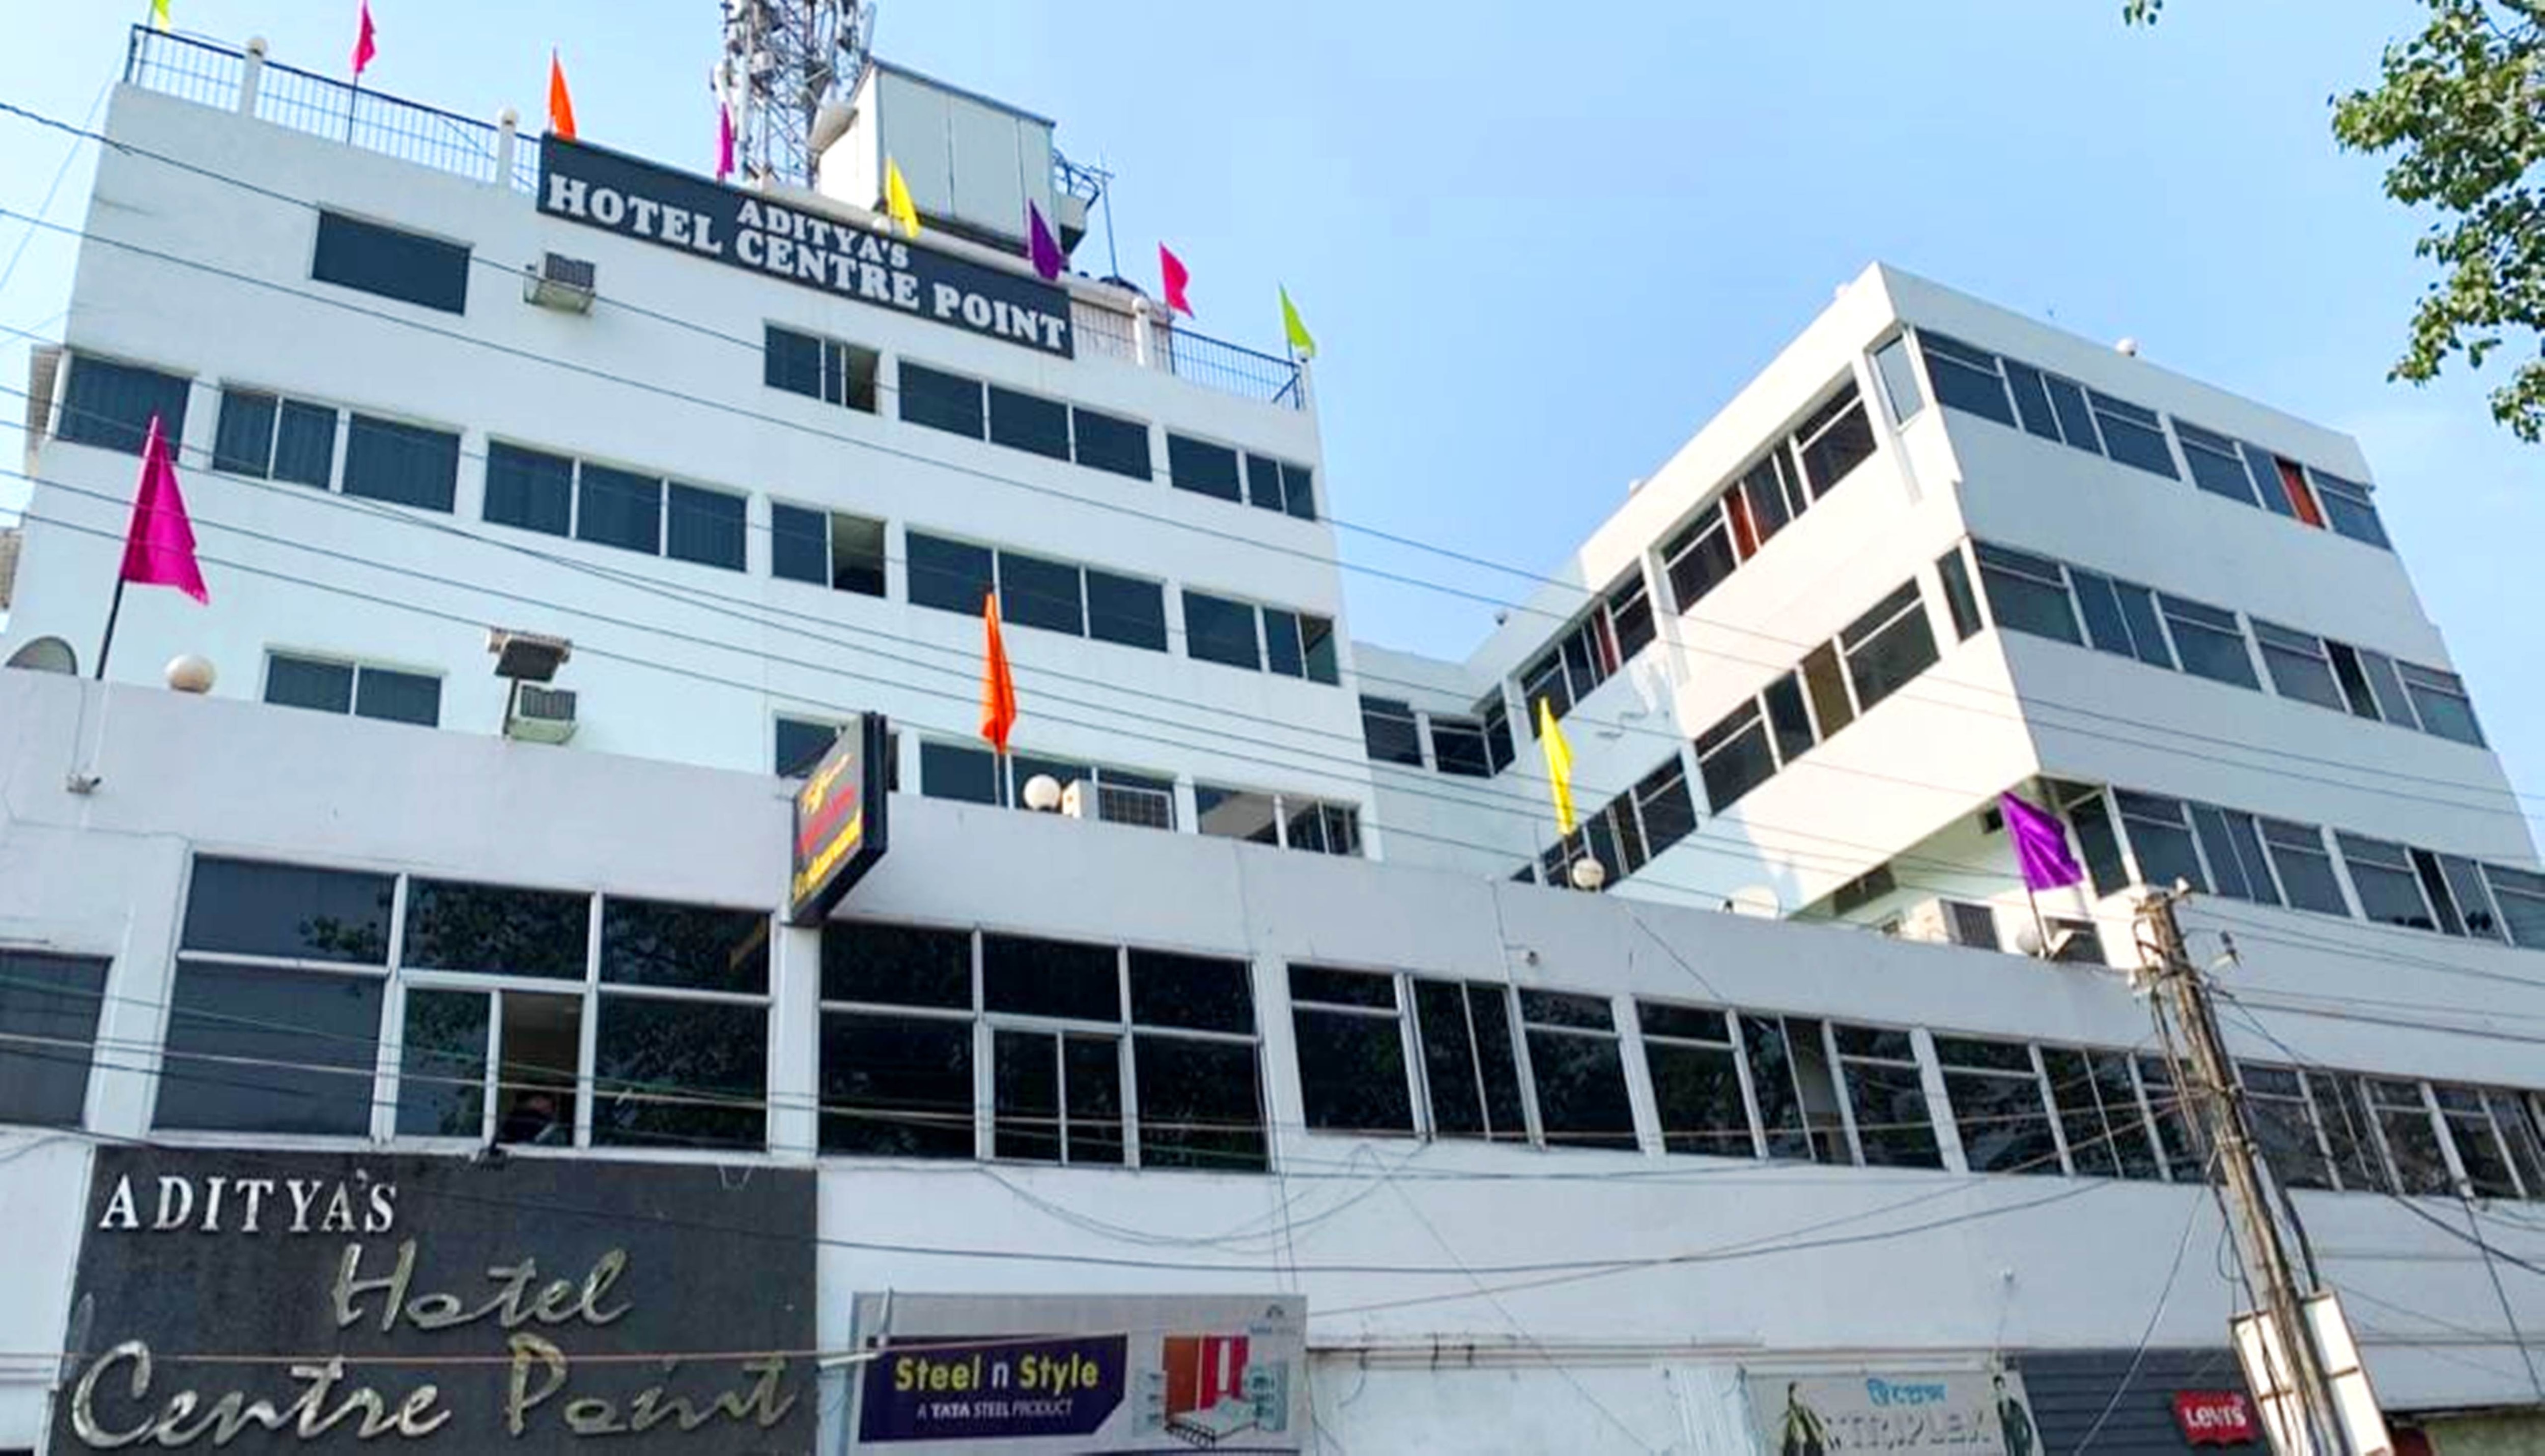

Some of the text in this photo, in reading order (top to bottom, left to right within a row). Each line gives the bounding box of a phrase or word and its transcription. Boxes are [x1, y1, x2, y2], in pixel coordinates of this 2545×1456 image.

[547, 173, 1067, 349] HOTEL CENTRE POINT
[737, 196, 910, 267] ADITYA'S
[99, 1169, 397, 1233] ADITYA'S
[332, 1239, 632, 1331] Hotel
[72, 1332, 795, 1448] Centre Point
[895, 1352, 1098, 1396] Steel n Style
[918, 1404, 926, 1419] A
[931, 1403, 969, 1418] TATA
[974, 1401, 1008, 1417] STEEL
